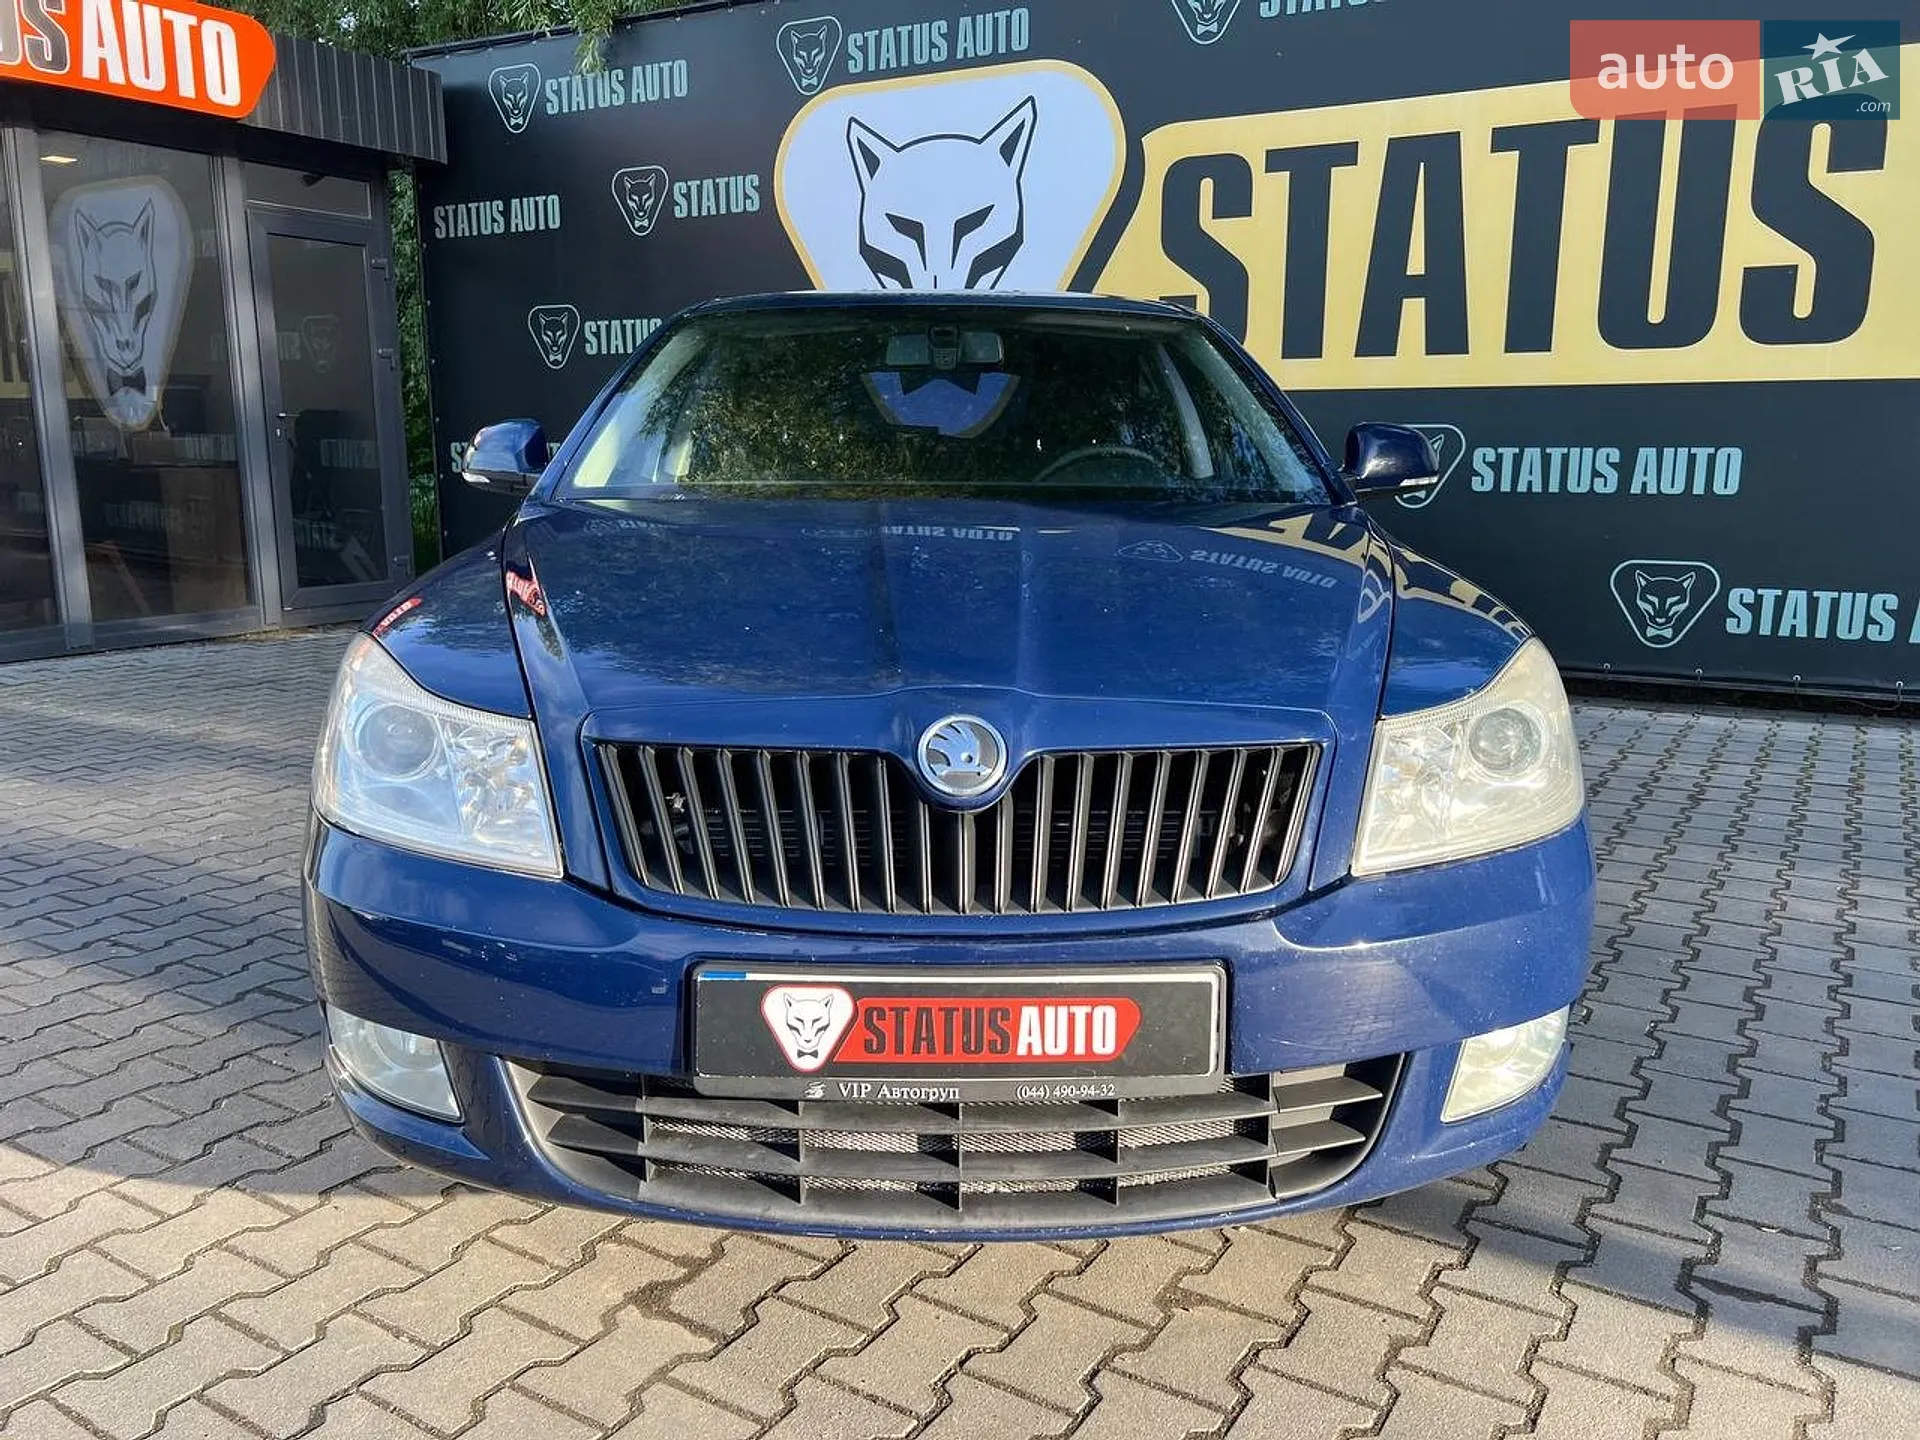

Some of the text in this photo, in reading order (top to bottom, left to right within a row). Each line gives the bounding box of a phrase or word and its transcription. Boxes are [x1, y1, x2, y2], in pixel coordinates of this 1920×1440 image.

[81, 0, 242, 107] AUTO
[848, 7, 1030, 74] STATUS AUTO
[545, 59, 689, 116] STATUS AUTO
[434, 194, 561, 239] STATUS AUTO
[673, 174, 761, 219] STATUS
[1159, 93, 1889, 361] STATUS
[1471, 446, 1743, 496] STATUS AUTO
[1725, 587, 1899, 642] STATUS
[838, 1083, 872, 1098] VIP
[1016, 1083, 1115, 1099] (044) 490-94-32
